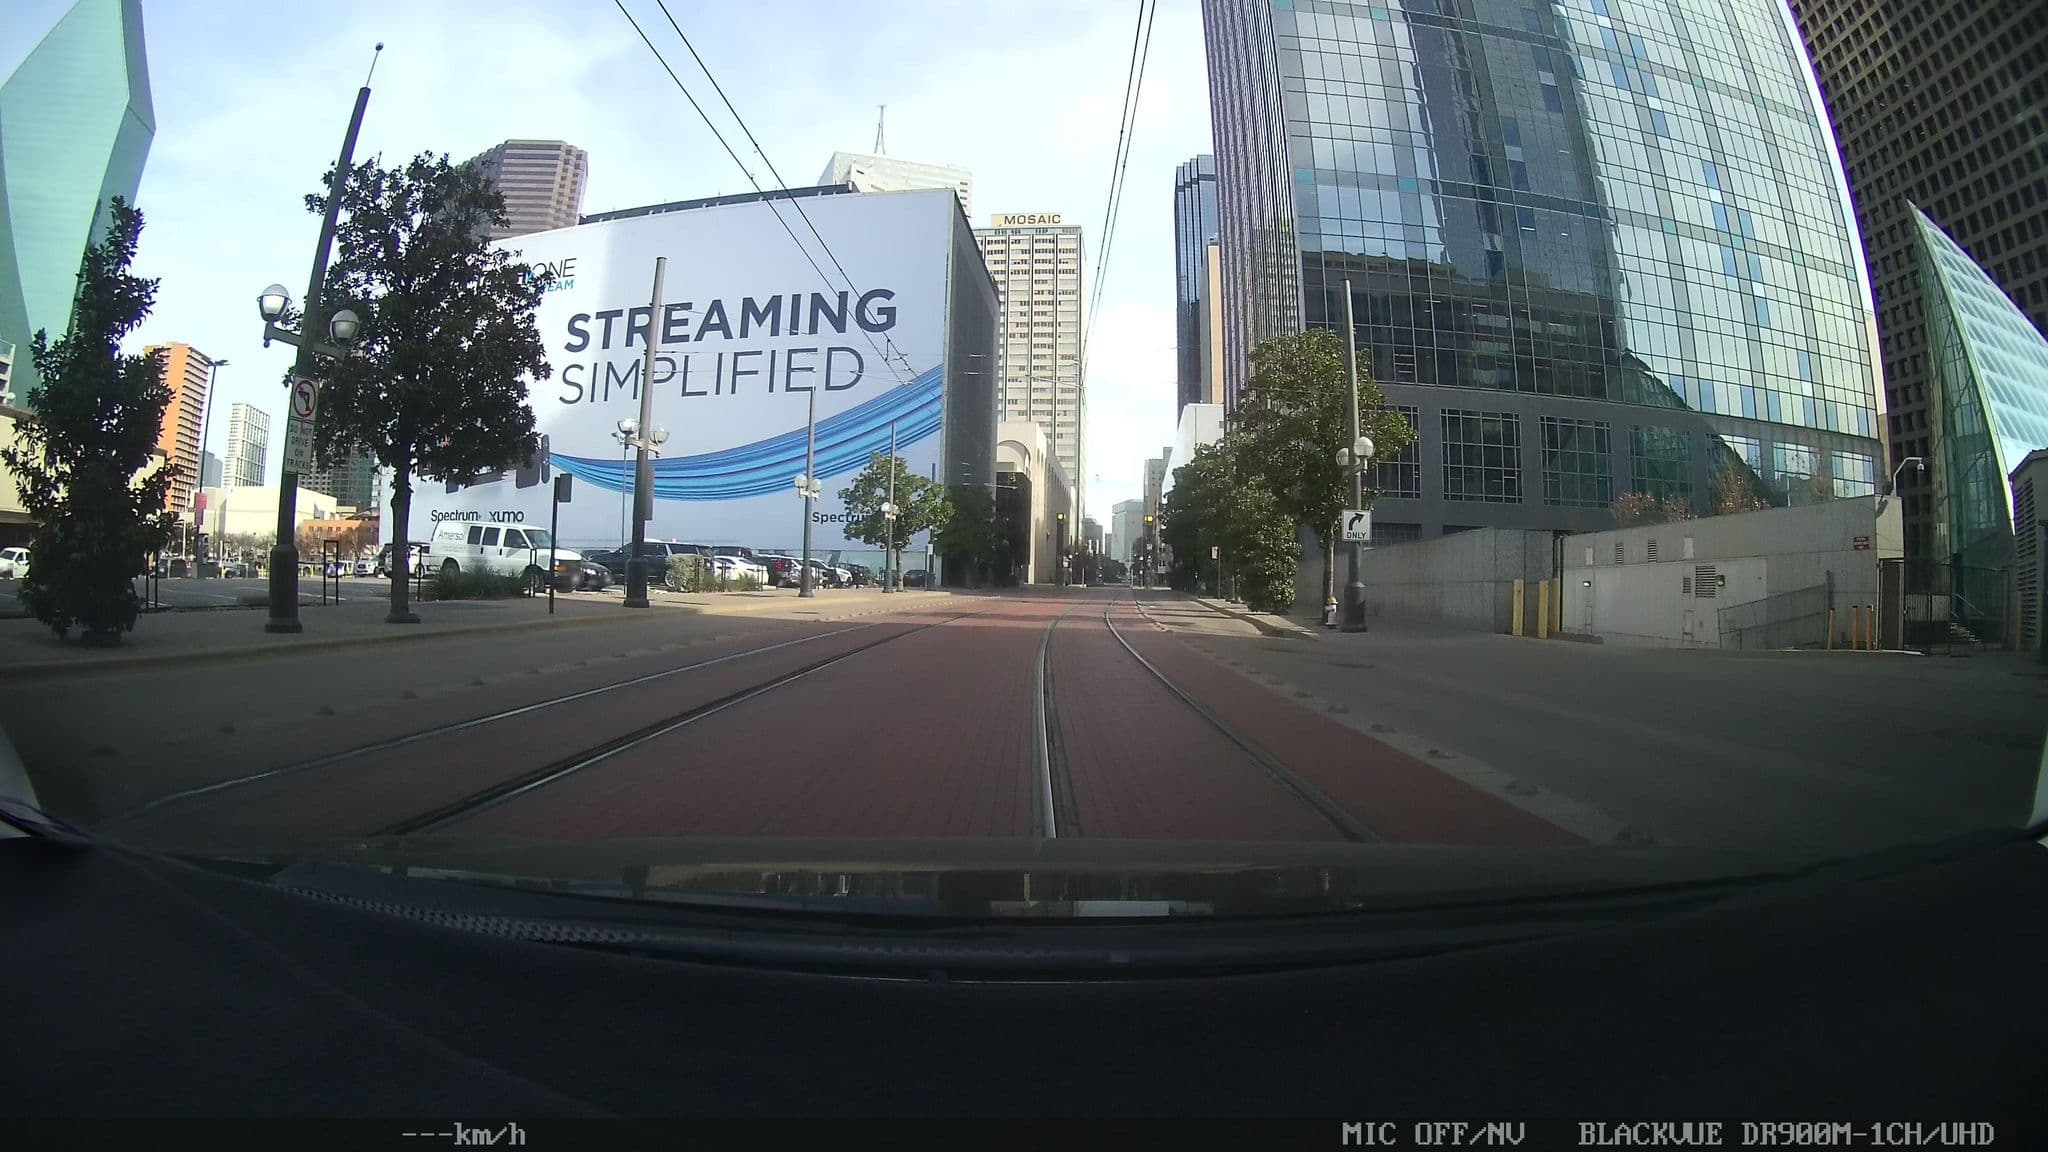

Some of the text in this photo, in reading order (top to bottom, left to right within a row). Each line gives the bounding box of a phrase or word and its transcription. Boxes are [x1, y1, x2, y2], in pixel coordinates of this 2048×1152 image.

[1004, 214, 1061, 225] MOSAIC
[532, 257, 577, 279] ONE
[564, 288, 897, 353] STREAMING
[558, 346, 865, 405] SIMPLIFIED
[290, 424, 299, 434] DO
[291, 436, 309, 448] DRIVE
[294, 448, 304, 458] ON
[287, 457, 310, 470] TRACKS
[431, 509, 525, 523] Spectrum xumo
[812, 511, 865, 524] Spectru
[1346, 531, 1367, 540] ONLY
